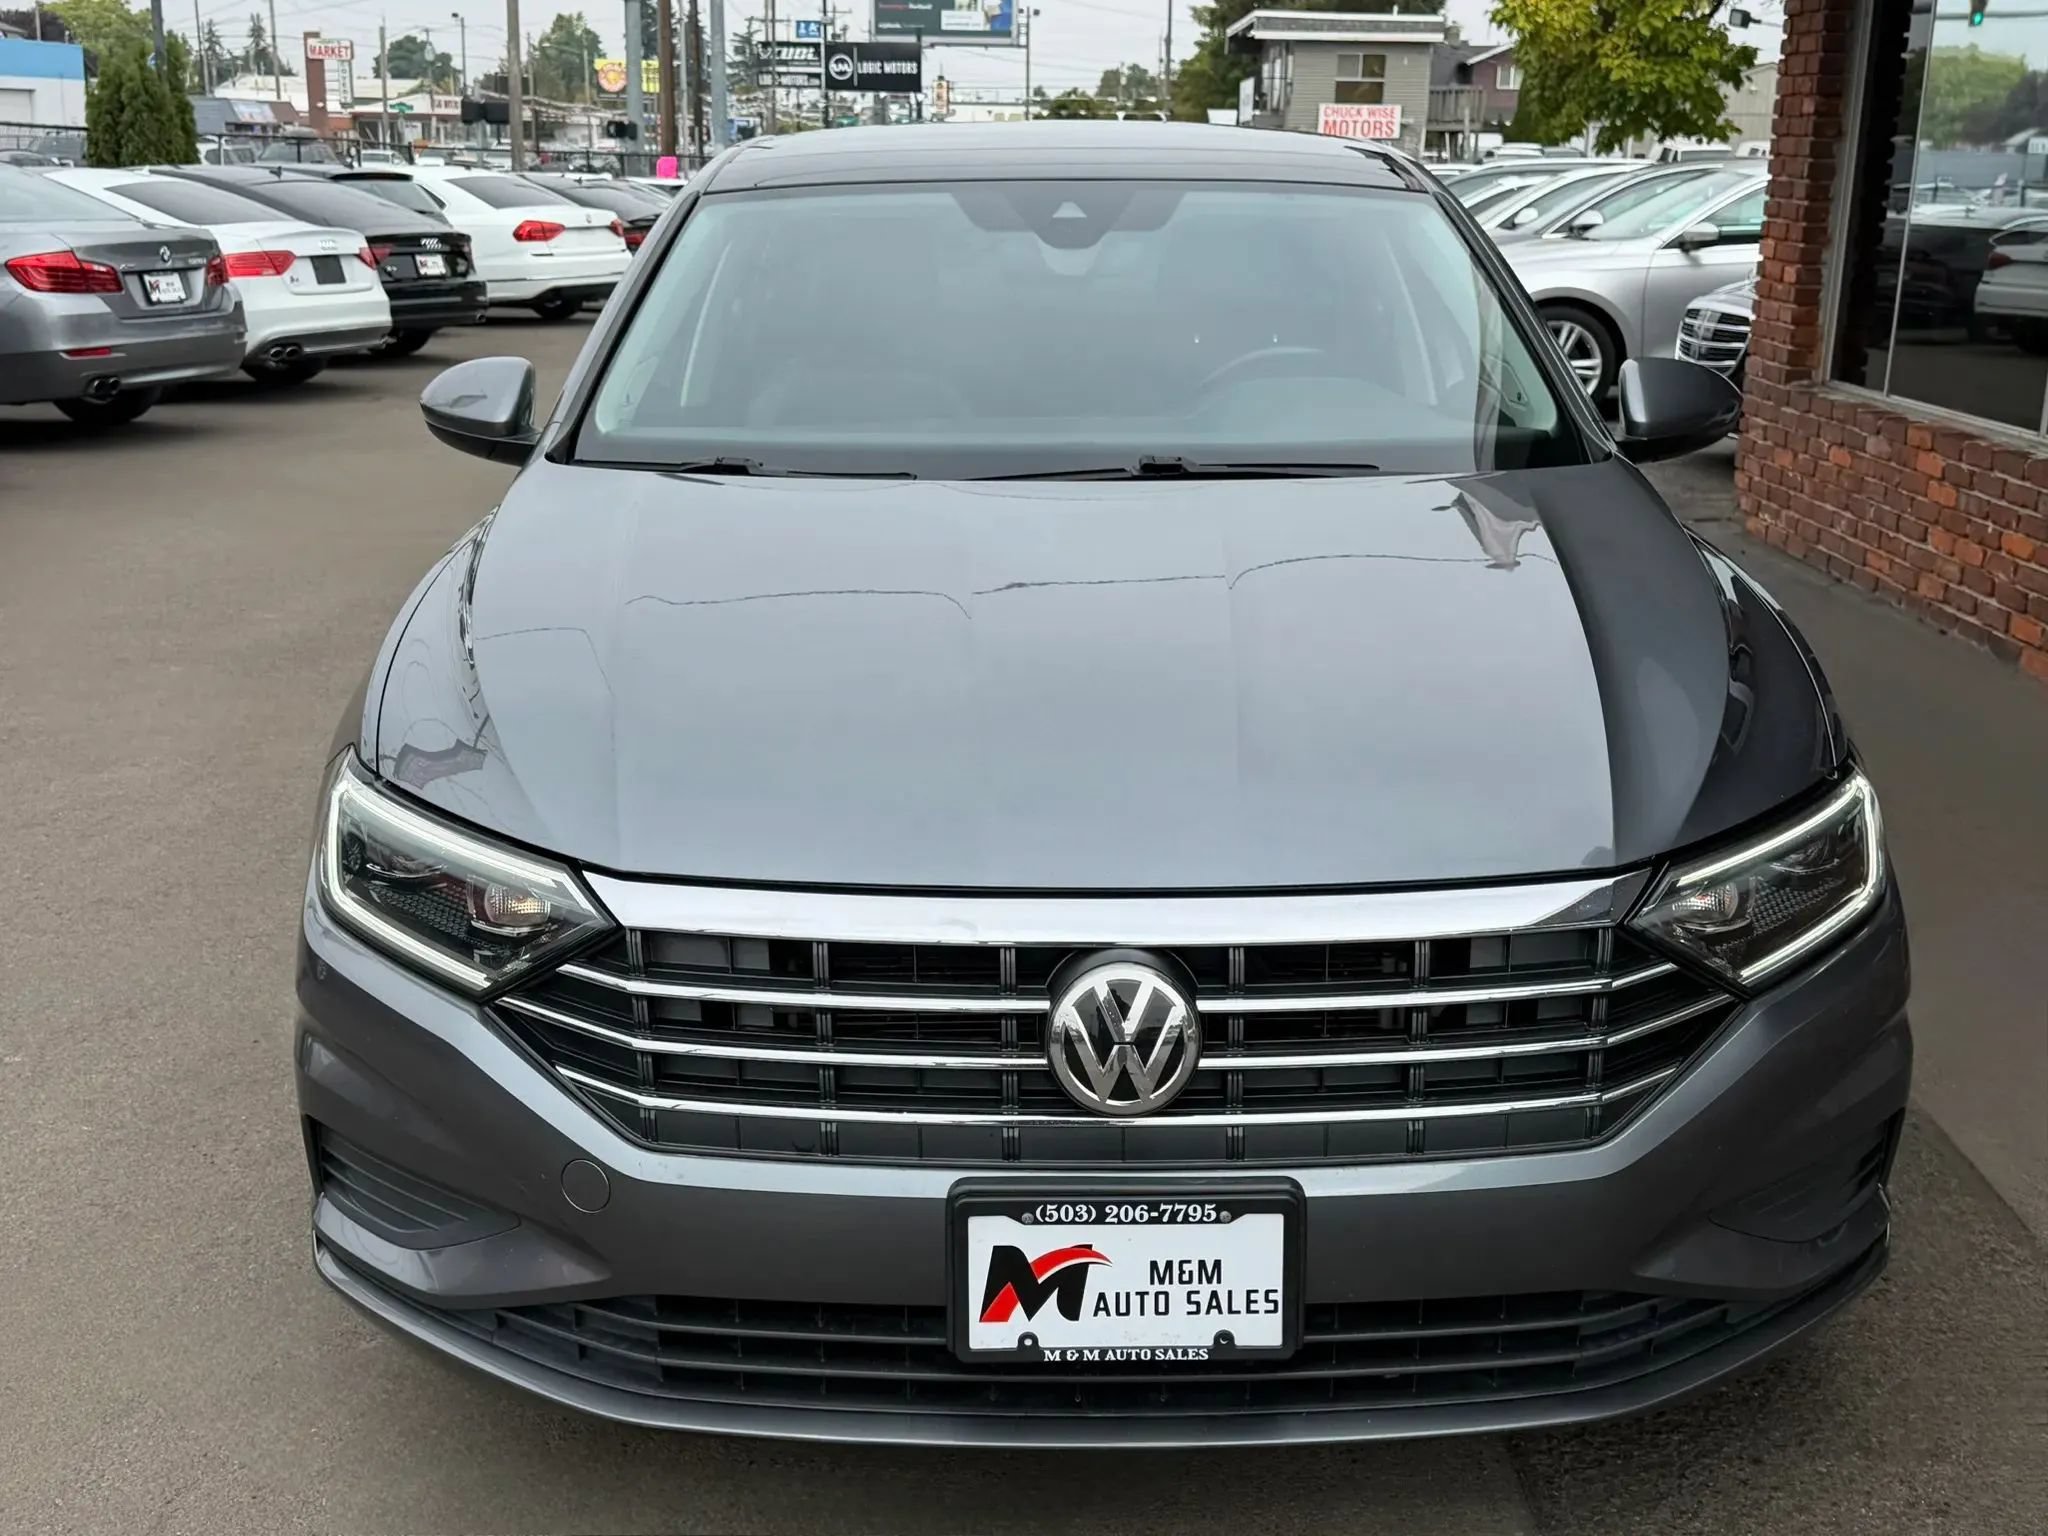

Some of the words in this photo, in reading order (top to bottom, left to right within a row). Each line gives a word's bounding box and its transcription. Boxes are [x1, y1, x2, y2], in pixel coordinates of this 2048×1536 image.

[309, 44, 350, 58] MARKET
[857, 61, 882, 74] LOGIC
[883, 61, 918, 75] MOTORS
[1324, 106, 1362, 119] CHUCK
[1367, 107, 1396, 119] WISE
[1323, 119, 1395, 138] MOTORS
[1035, 1203, 1097, 1223] (503)
[1104, 1203, 1218, 1223] 206-7795
[1149, 1258, 1222, 1287] M&M
[1092, 1290, 1171, 1318] AUTO
[1185, 1288, 1280, 1316] SALES
[1043, 1348, 1061, 1362] M
[1066, 1348, 1080, 1362] &
[1083, 1348, 1101, 1361] M
[1104, 1348, 1152, 1361] AUTO
[1155, 1347, 1210, 1361] SALES
